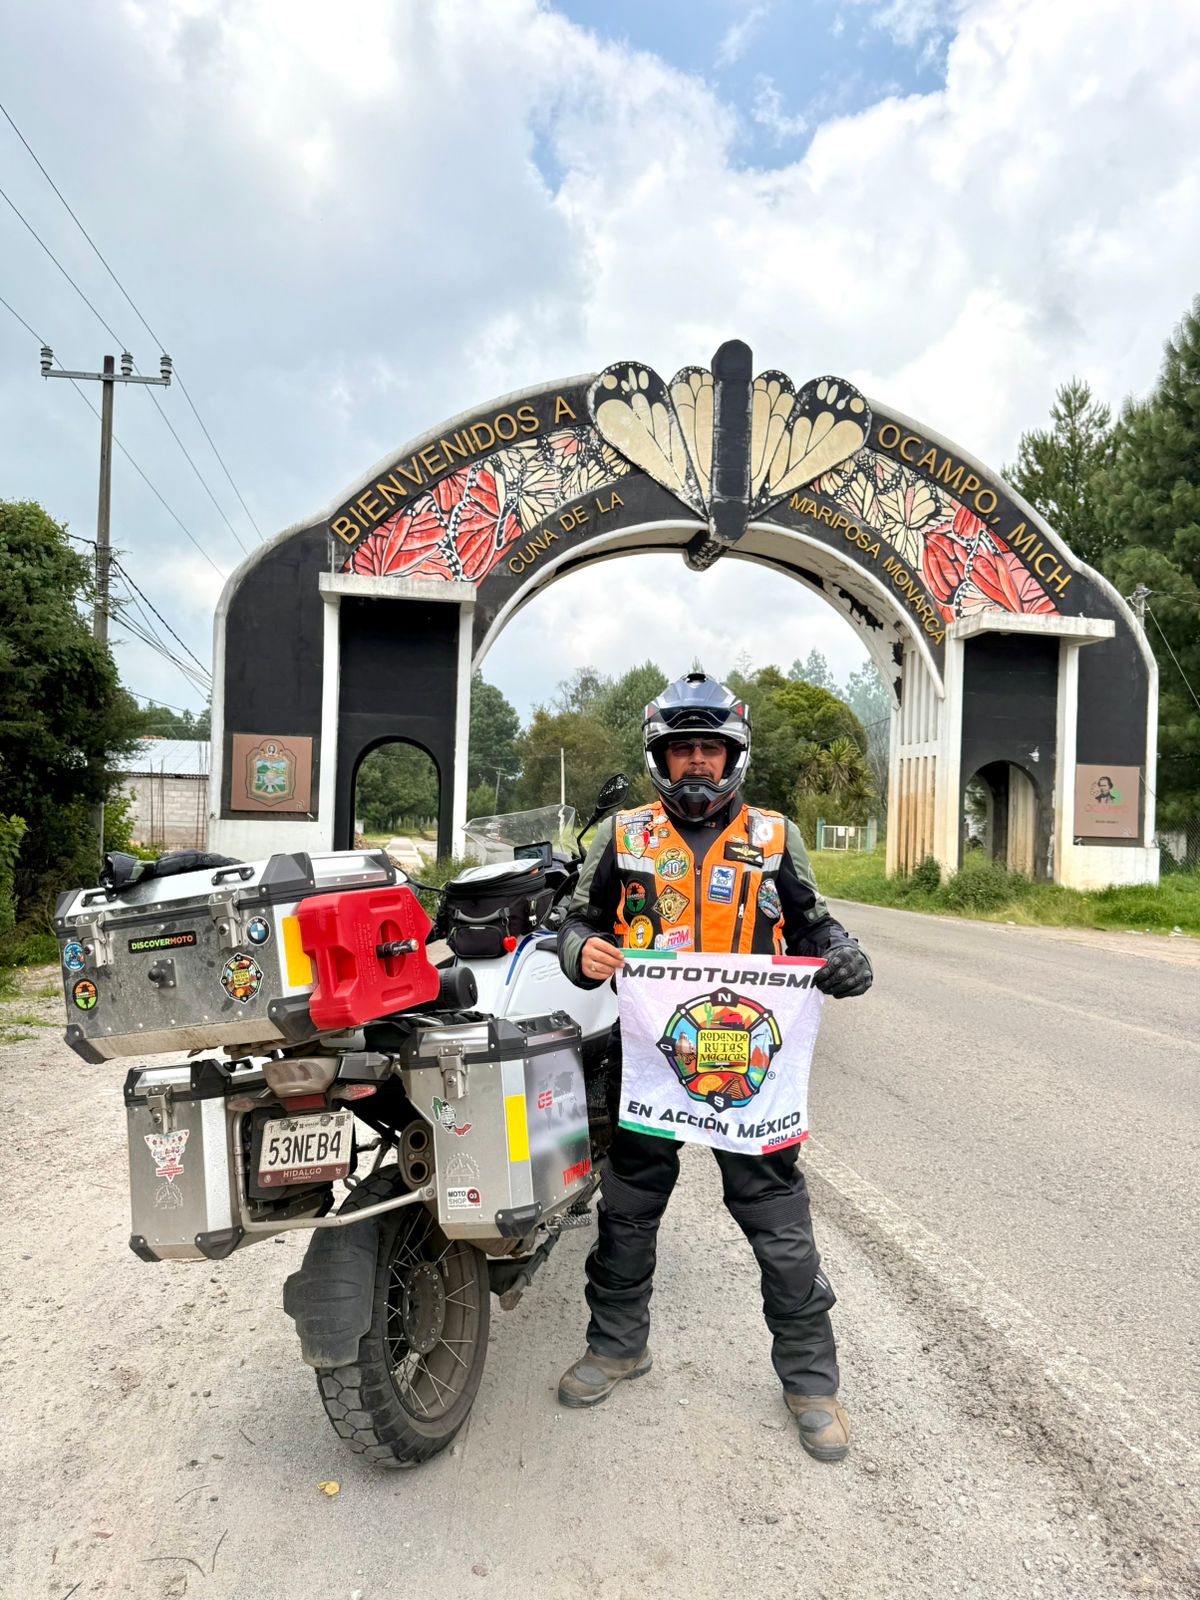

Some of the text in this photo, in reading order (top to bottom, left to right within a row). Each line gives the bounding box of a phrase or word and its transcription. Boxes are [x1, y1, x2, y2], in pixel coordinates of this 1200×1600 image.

[331, 396, 1072, 598] BIENVENIDOS A OCAMPO, MICH.
[508, 491, 946, 646] CUNA DE LA MARIPOSA MONARCA
[667, 861, 680, 874] 10
[131, 934, 193, 950] DISCOVERMOTO
[622, 963, 816, 990] MOTOTURISM
[717, 992, 732, 1003] N
[713, 1096, 725, 1108] S
[627, 1100, 801, 1138] EN ACCIÓN MÉXICO
[268, 1130, 342, 1166] 53NEB4
[283, 1167, 322, 1178] HIDALGO
